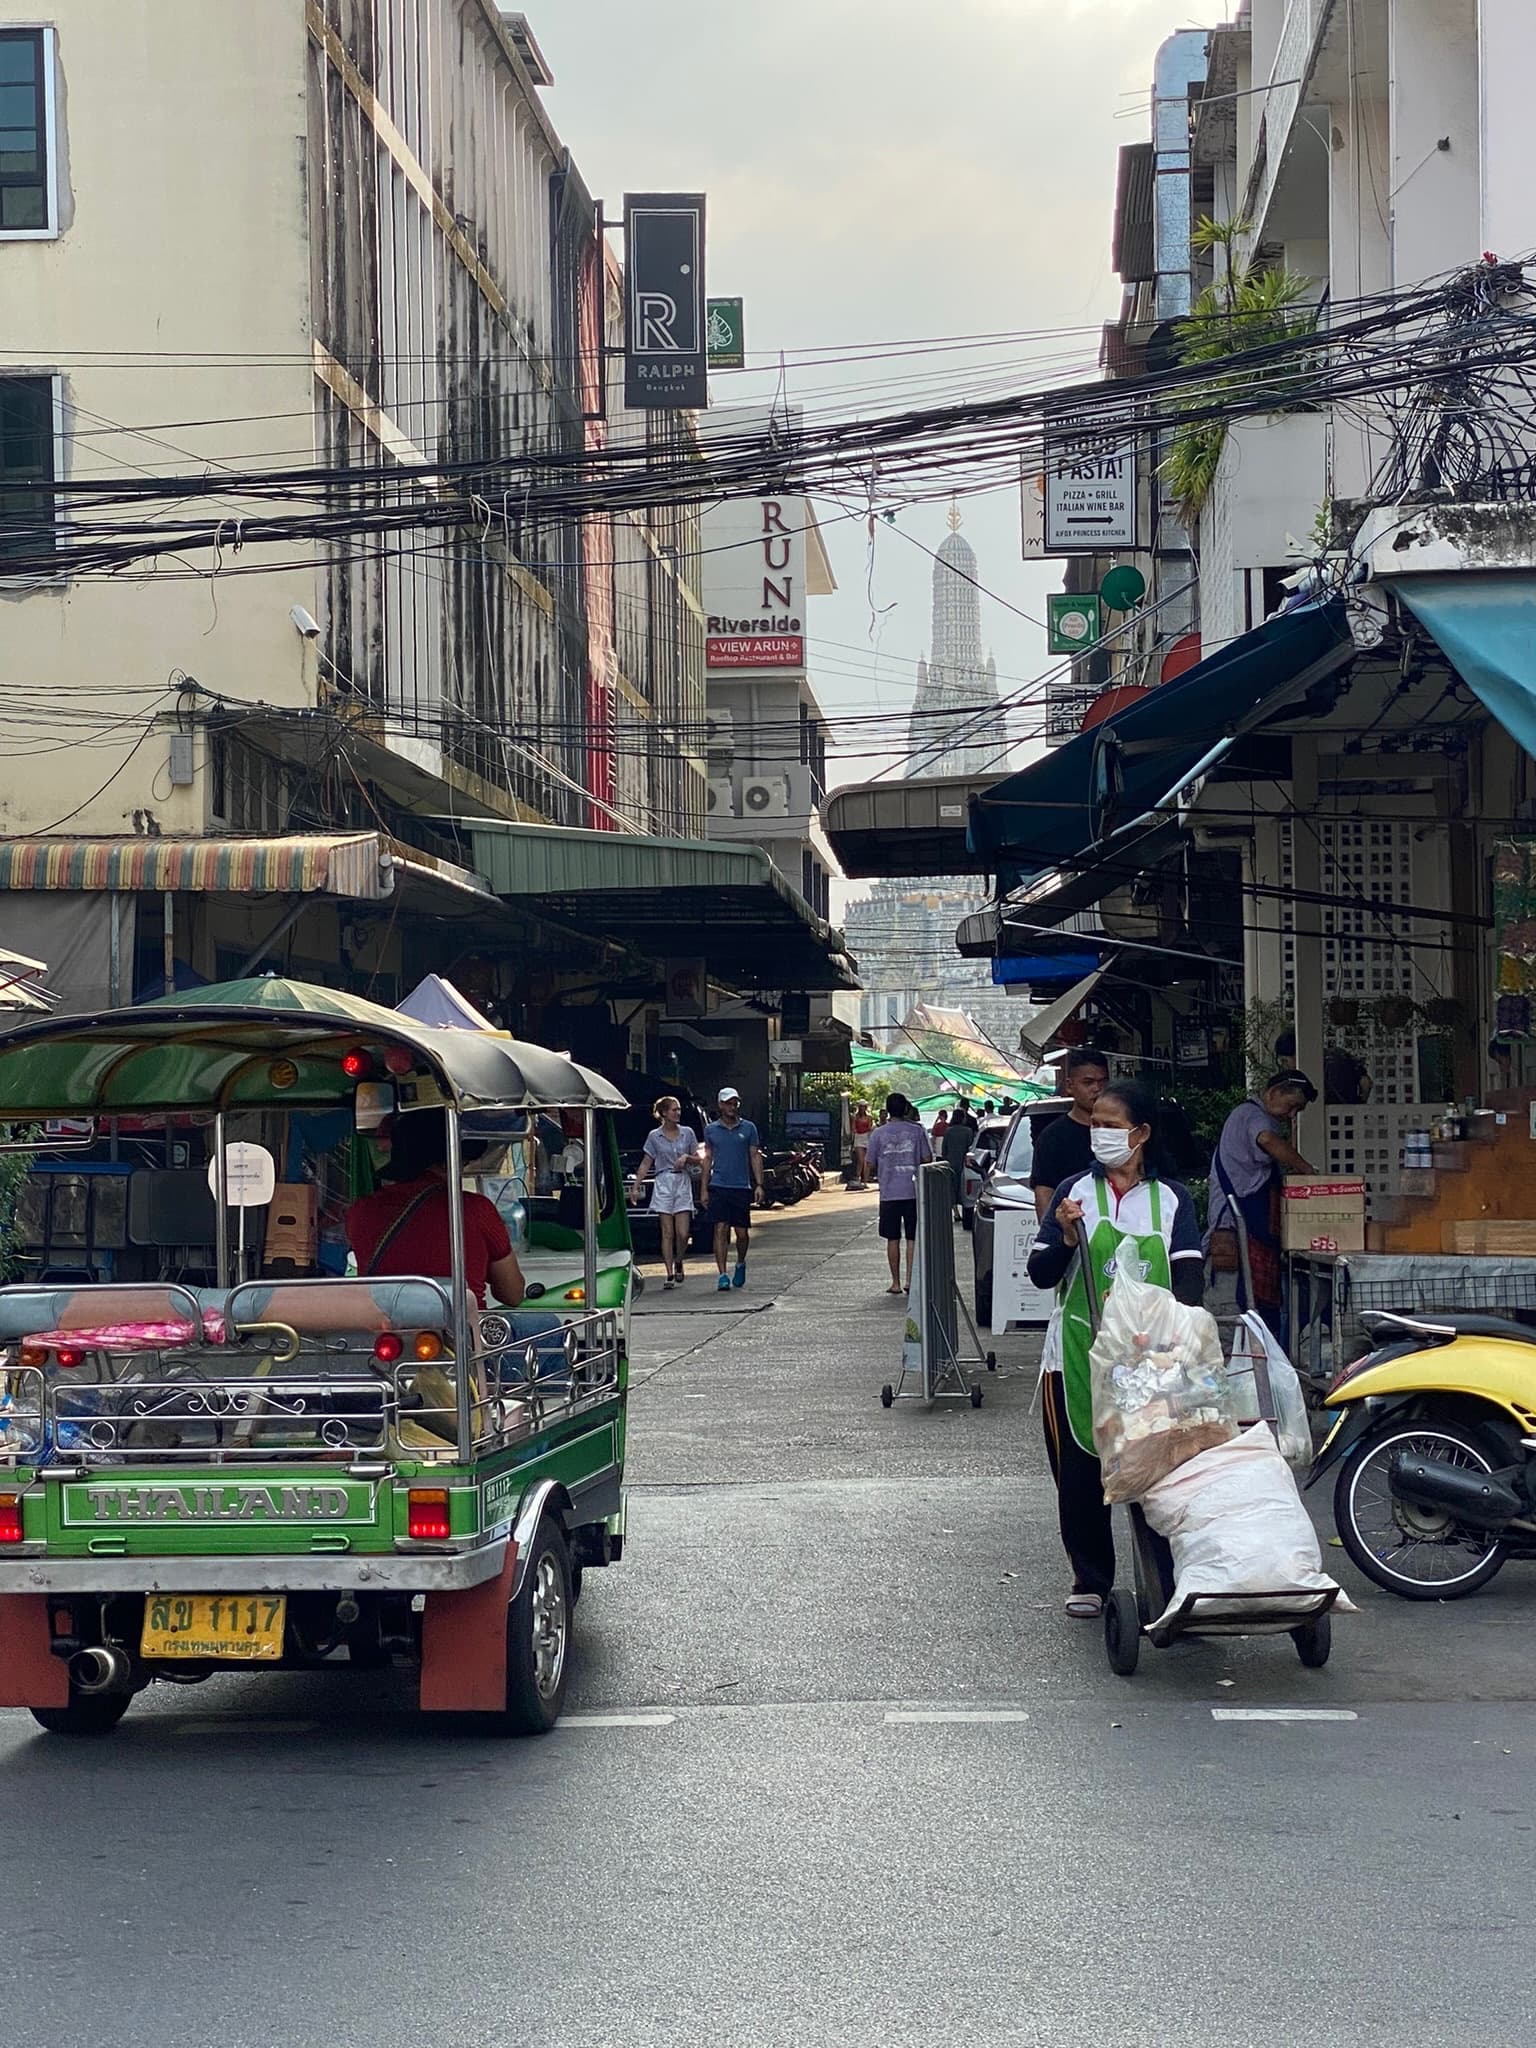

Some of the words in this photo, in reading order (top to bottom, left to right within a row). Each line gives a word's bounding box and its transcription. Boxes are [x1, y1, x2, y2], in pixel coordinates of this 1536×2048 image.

[638, 365, 695, 378] RALPH
[646, 384, 686, 392] Bangkok
[1063, 491, 1086, 499] PIZZA
[1095, 490, 1118, 499] GRILL
[1056, 502, 1085, 512] ITALIAN
[1087, 502, 1107, 511] WINE
[1109, 502, 1125, 511] BAR
[1102, 529, 1126, 537] KITCHEN
[761, 501, 793, 609] RUN
[707, 615, 801, 634] Riverside
[718, 642, 751, 653] VIEW
[753, 641, 790, 652] ARUN
[779, 653, 785, 661] &
[88, 1486, 349, 1520] THAILAND
[209, 1600, 281, 1632] 1117
